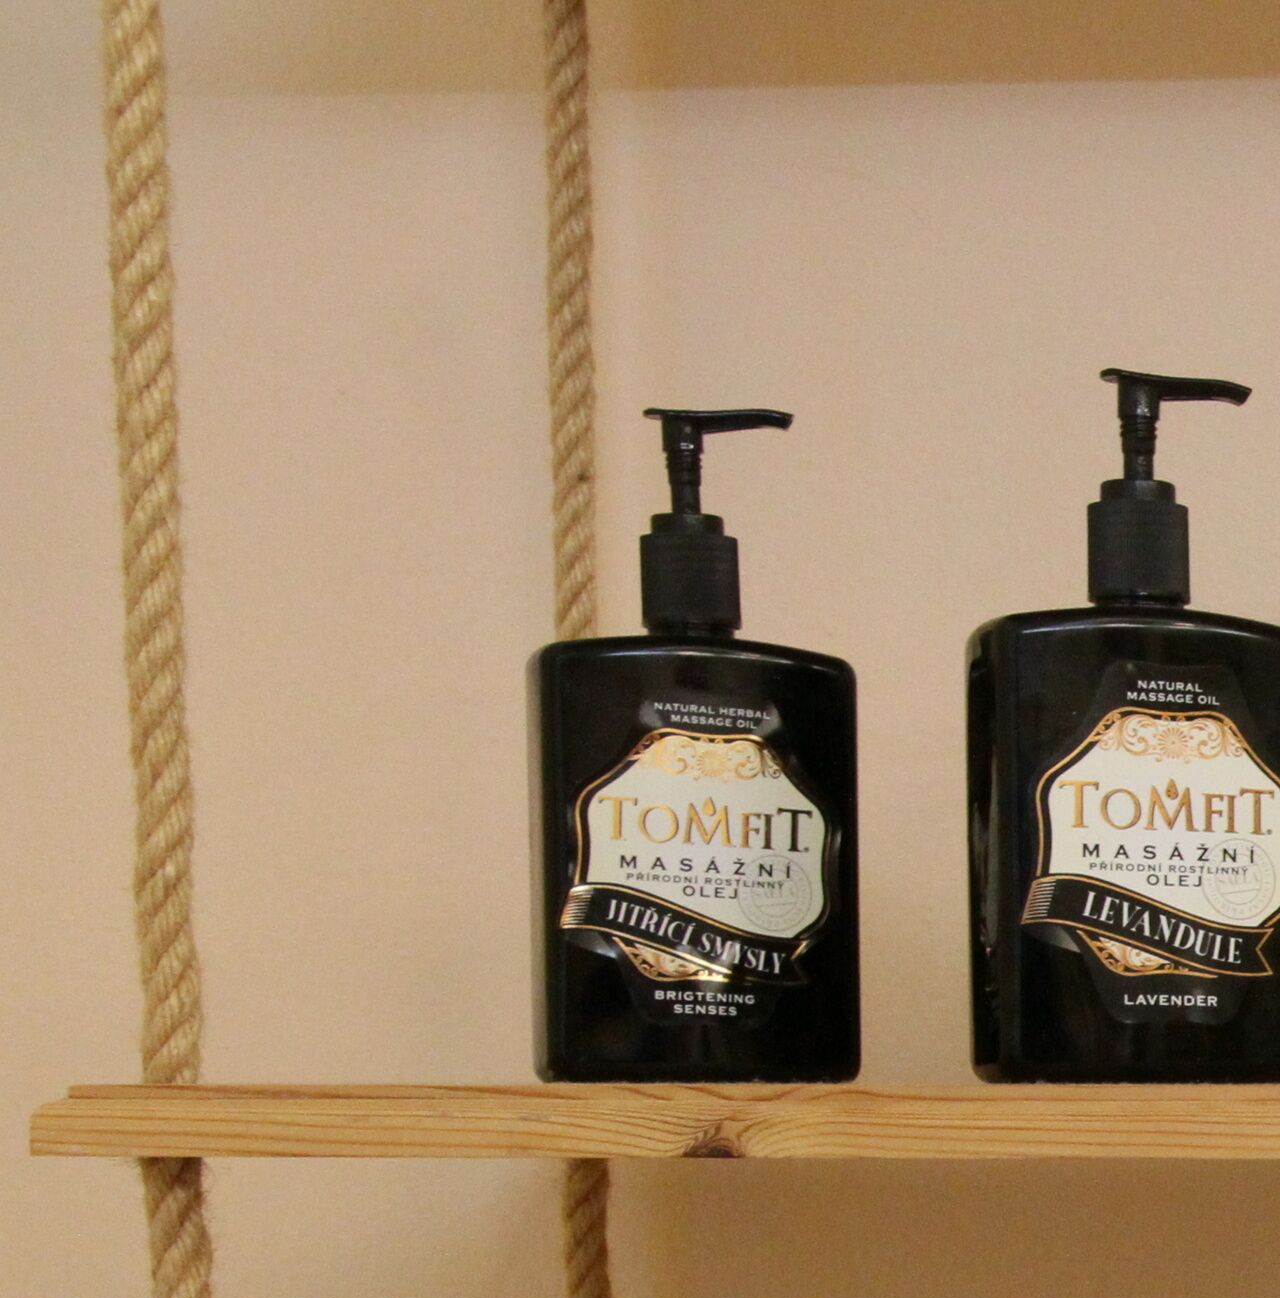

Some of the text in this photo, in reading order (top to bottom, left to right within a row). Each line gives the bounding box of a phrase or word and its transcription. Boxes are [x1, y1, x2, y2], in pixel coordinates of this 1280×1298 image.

[1137, 680, 1203, 693] NATURAL
[1127, 691, 1220, 706] MASSAGE OIL
[654, 702, 771, 720] NATURAL HERBAL
[670, 714, 757, 730] MASSAGE OIL
[1082, 842, 1255, 864] MASÁŽNÍ
[620, 855, 791, 879] MASÁŽNÍ
[1089, 861, 1248, 876] PŘÍRODNÍ ROSTLINNÝ
[626, 872, 784, 890] PŘÍRODNÍ ROSTLINNÝ
[1146, 874, 1202, 888] OLEJ
[683, 886, 738, 899] OLEJ
[1082, 890, 1243, 965] LEVANDULE
[606, 899, 786, 975] JITŘÍCÍ SMYSLY
[654, 990, 755, 1005] BRIGTENING
[1124, 994, 1218, 1007] LAVENDER
[673, 1003, 738, 1017] SENSES
